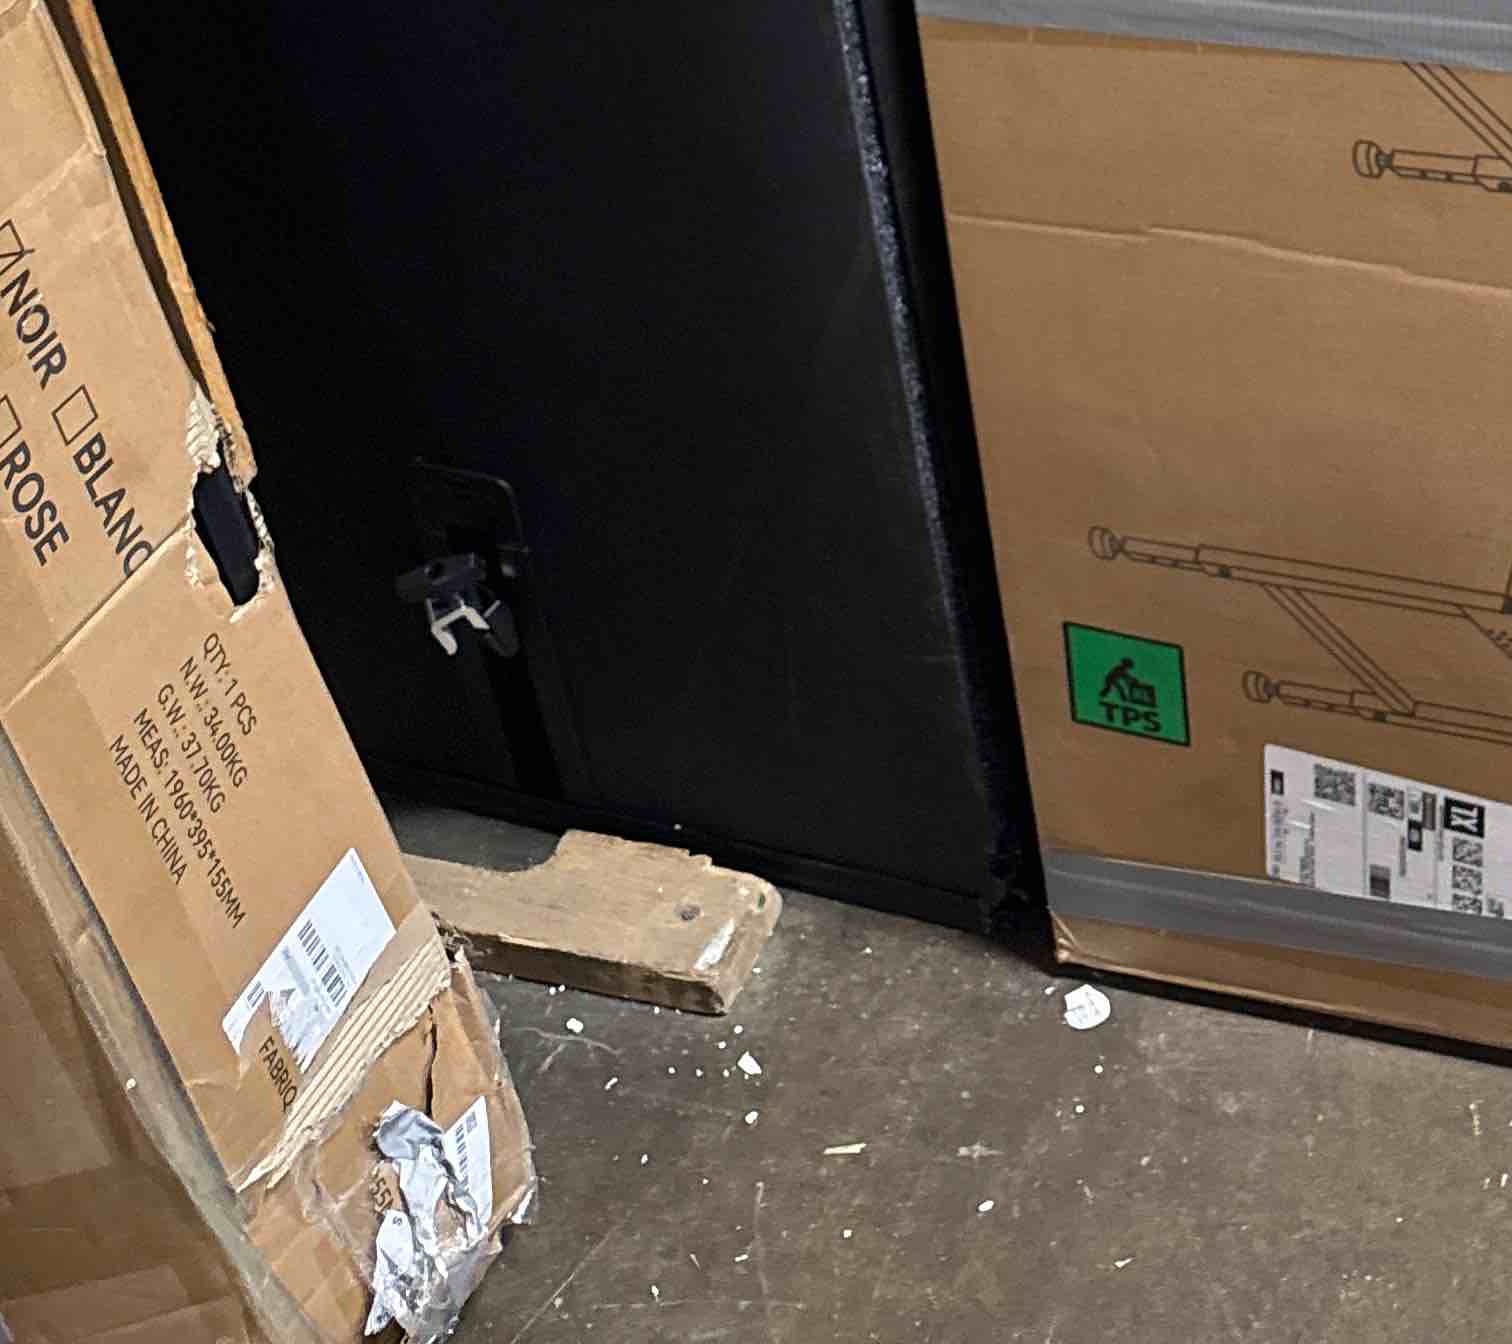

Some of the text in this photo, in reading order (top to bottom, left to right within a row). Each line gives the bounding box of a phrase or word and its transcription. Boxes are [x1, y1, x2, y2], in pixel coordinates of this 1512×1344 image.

[1, 268, 68, 391] NOIR
[1, 439, 71, 567] ROSE
[202, 631, 233, 681] QTY:
[229, 693, 257, 736] PCS
[1098, 700, 1162, 733] TPS
[133, 706, 170, 770] MEAS:
[179, 732, 226, 815] 37.70KG
[202, 708, 248, 788] 34.00KG
[109, 733, 188, 886] MADE IN CHINA
[1449, 805, 1479, 834] XL
